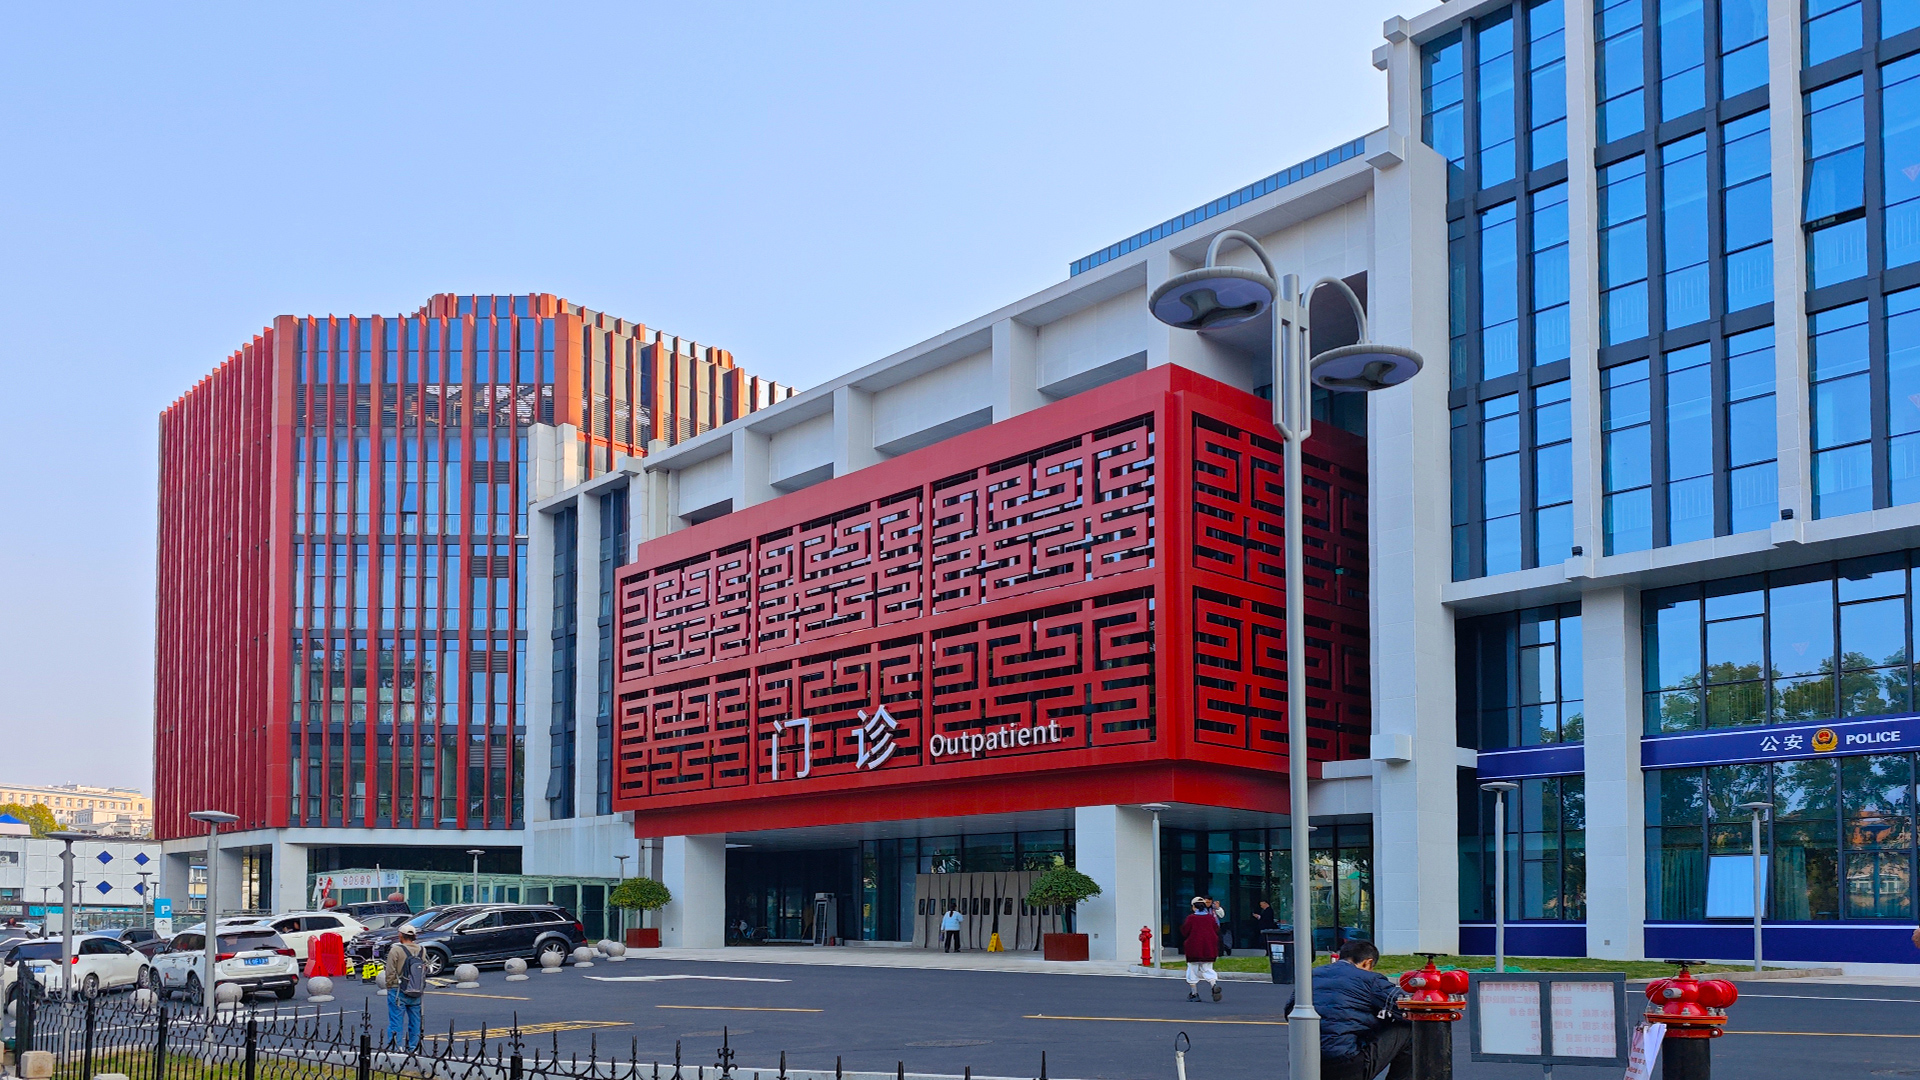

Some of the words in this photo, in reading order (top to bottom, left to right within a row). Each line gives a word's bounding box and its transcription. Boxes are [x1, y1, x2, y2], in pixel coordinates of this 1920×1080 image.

[773, 705, 899, 780] 门诊
[930, 719, 1062, 758] Outpatient
[1759, 734, 1803, 752] 公安
[1845, 731, 1901, 745] POLICE
[161, 905, 170, 915] P
